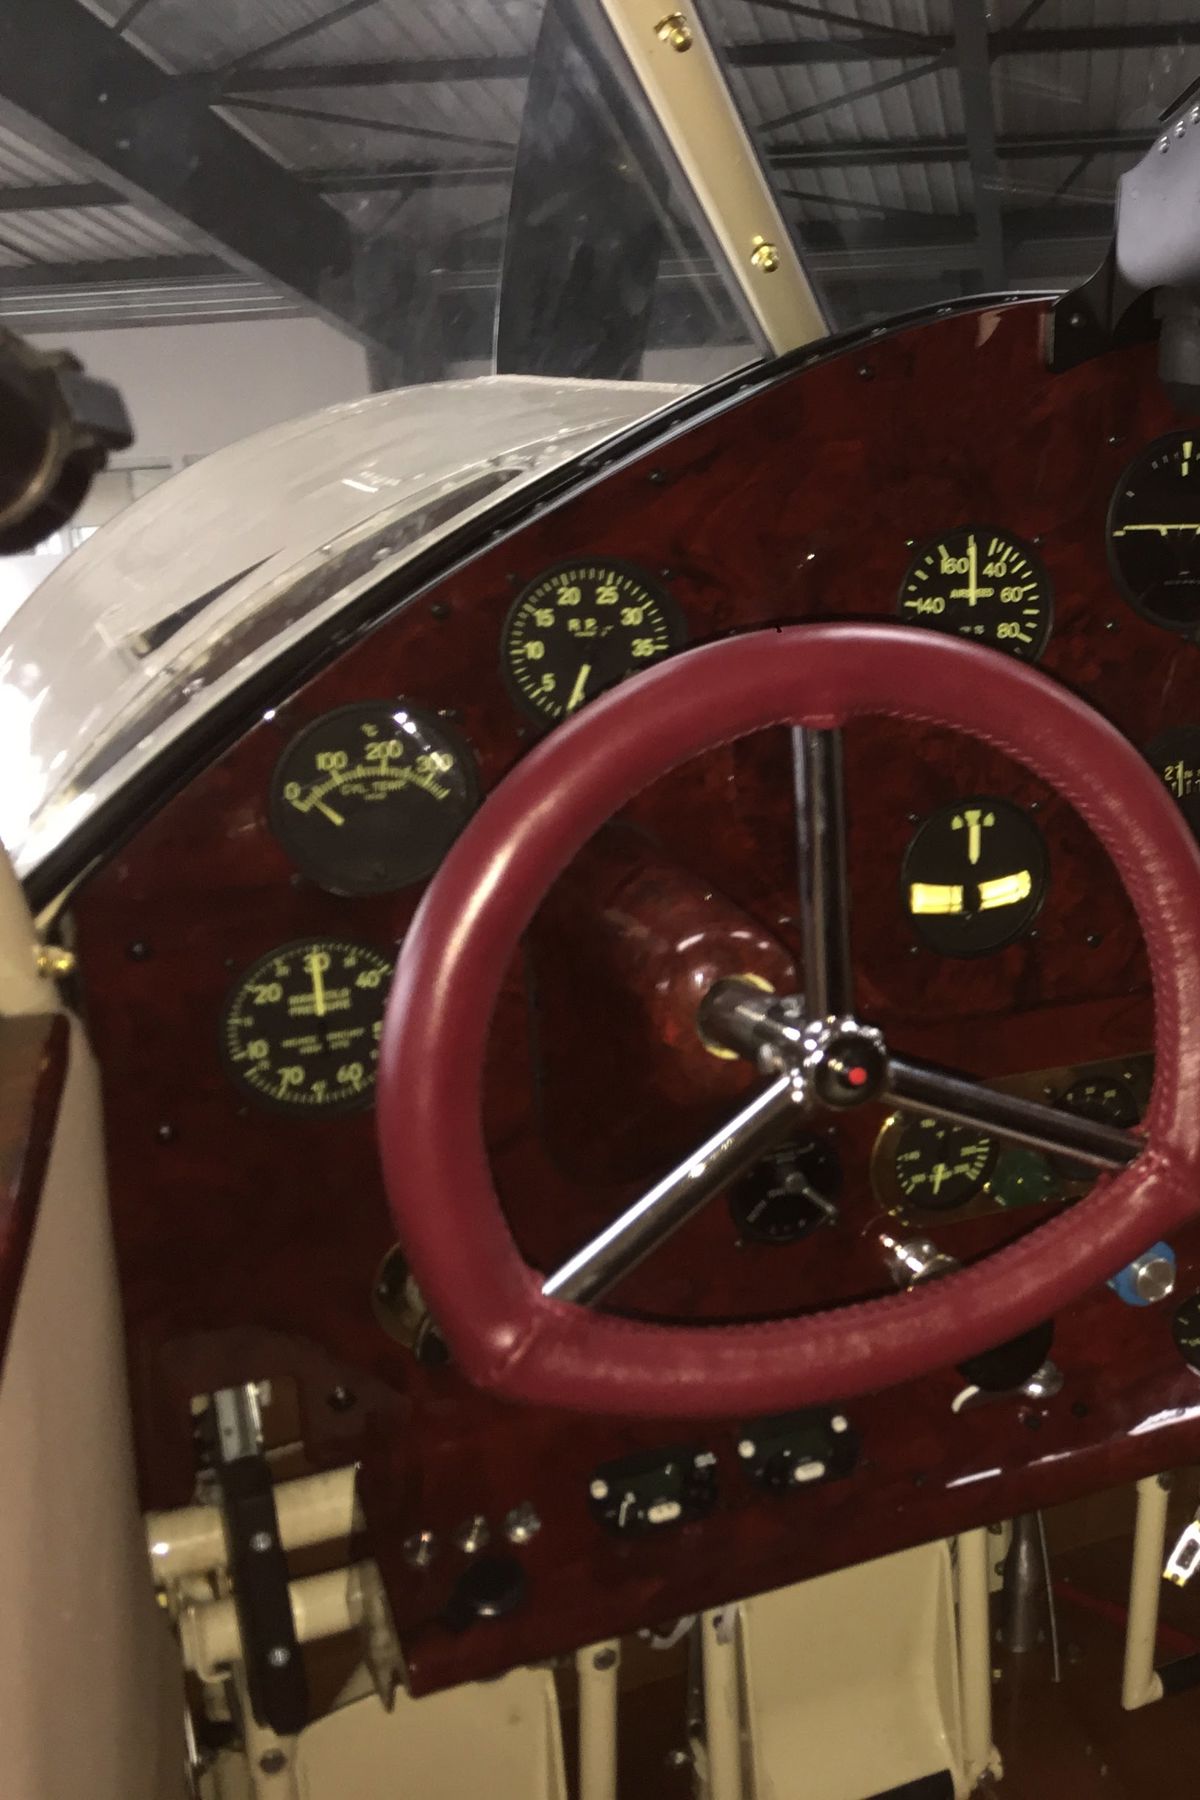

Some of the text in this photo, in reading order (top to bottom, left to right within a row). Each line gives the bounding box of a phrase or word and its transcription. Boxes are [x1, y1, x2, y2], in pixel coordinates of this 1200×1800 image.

[941, 558, 969, 574] 160
[983, 562, 1007, 577] 40
[557, 586, 581, 606] 20
[595, 586, 619, 605] 25
[1000, 587, 1023, 602] 60
[916, 597, 945, 614] 140
[534, 608, 555, 628] 15
[620, 607, 643, 626] 30
[997, 622, 1020, 638] 80
[525, 640, 545, 660] 10
[631, 638, 654, 657] 35
[541, 672, 556, 692] 5
[365, 739, 403, 760] 200
[315, 751, 348, 770] 100
[284, 781, 300, 800] 0
[255, 983, 283, 1004] 20
[278, 1065, 305, 1085] 70
